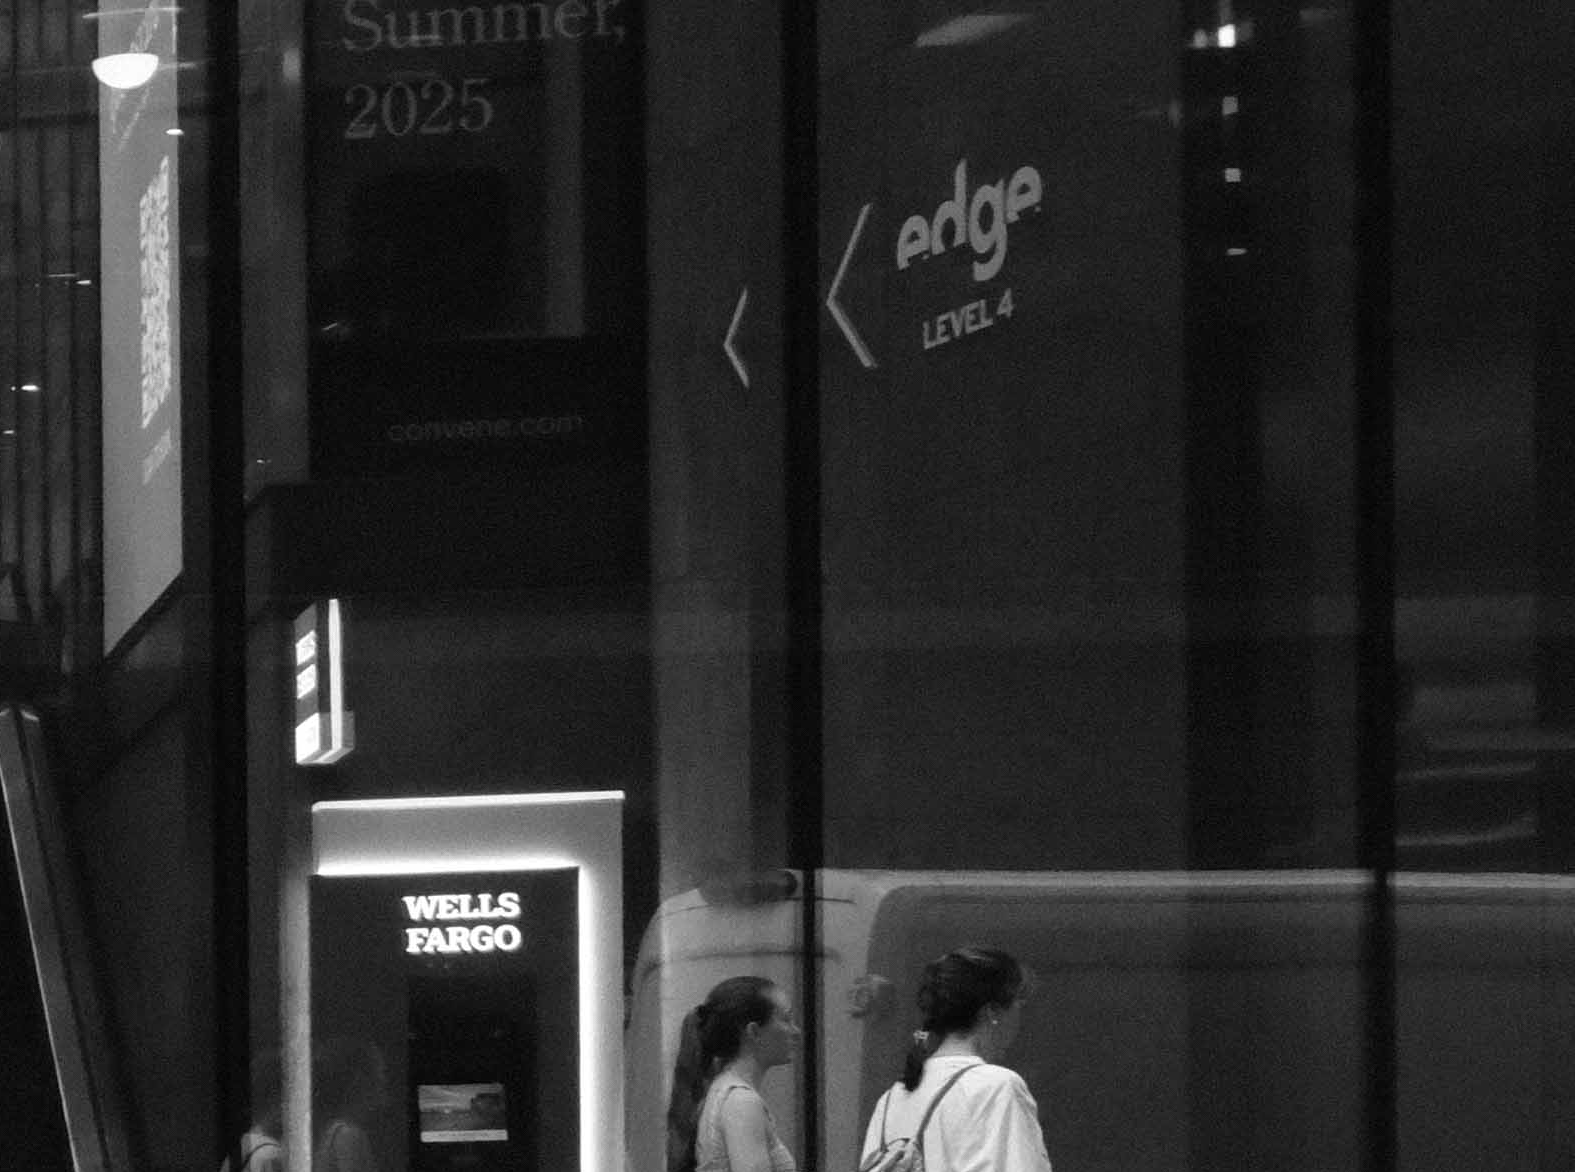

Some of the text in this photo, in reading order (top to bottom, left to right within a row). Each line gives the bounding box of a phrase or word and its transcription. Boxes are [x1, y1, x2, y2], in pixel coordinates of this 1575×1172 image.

[342, 0, 627, 51] Summer,
[344, 78, 495, 139] 2025
[897, 158, 1042, 281] edge
[923, 287, 1014, 350] LEVEL 4
[387, 416, 583, 443] convene.com
[401, 892, 522, 920] WELLS
[405, 924, 523, 955] FARGO
